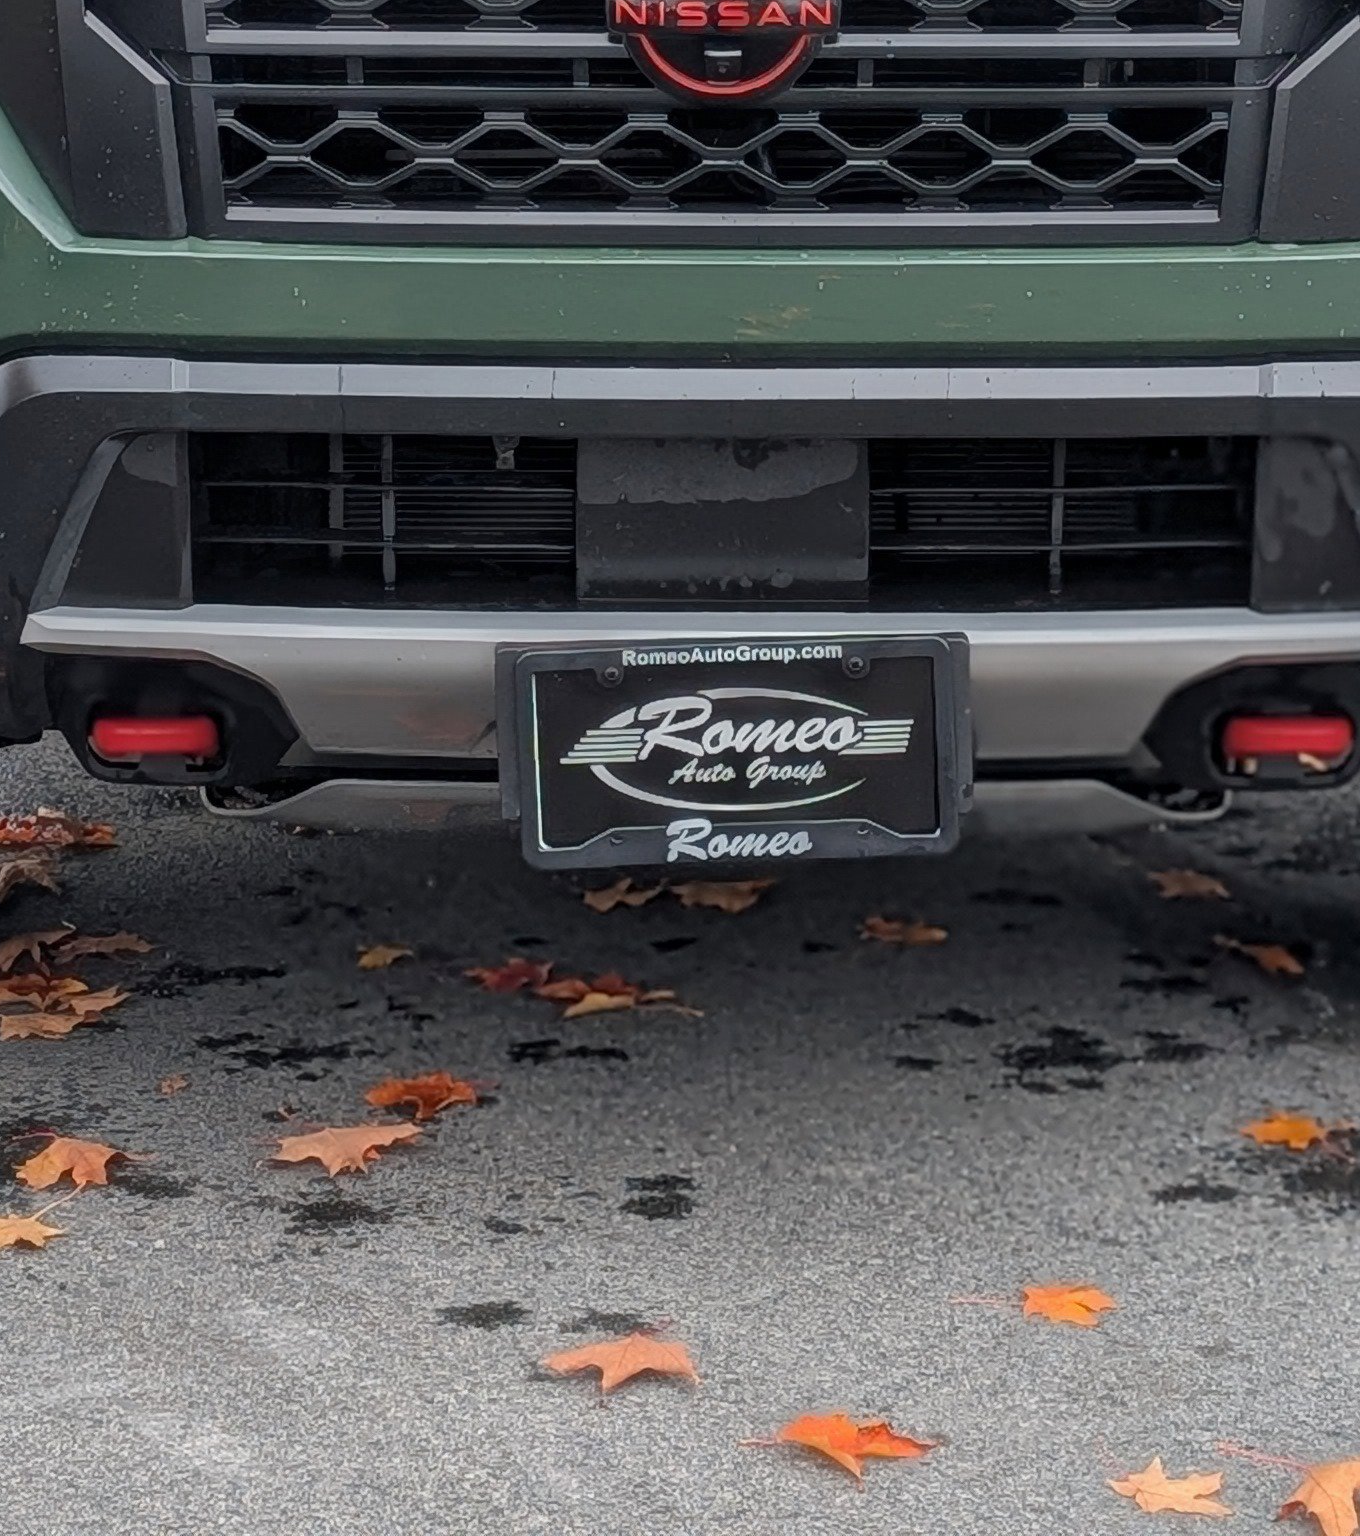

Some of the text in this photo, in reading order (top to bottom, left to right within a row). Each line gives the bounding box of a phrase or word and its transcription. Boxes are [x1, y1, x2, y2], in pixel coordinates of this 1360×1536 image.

[622, 645, 843, 666] RomeoAutoGroup.com
[637, 696, 862, 761] Romeo
[668, 755, 827, 789] Auto Group
[665, 818, 813, 862] Romeo
